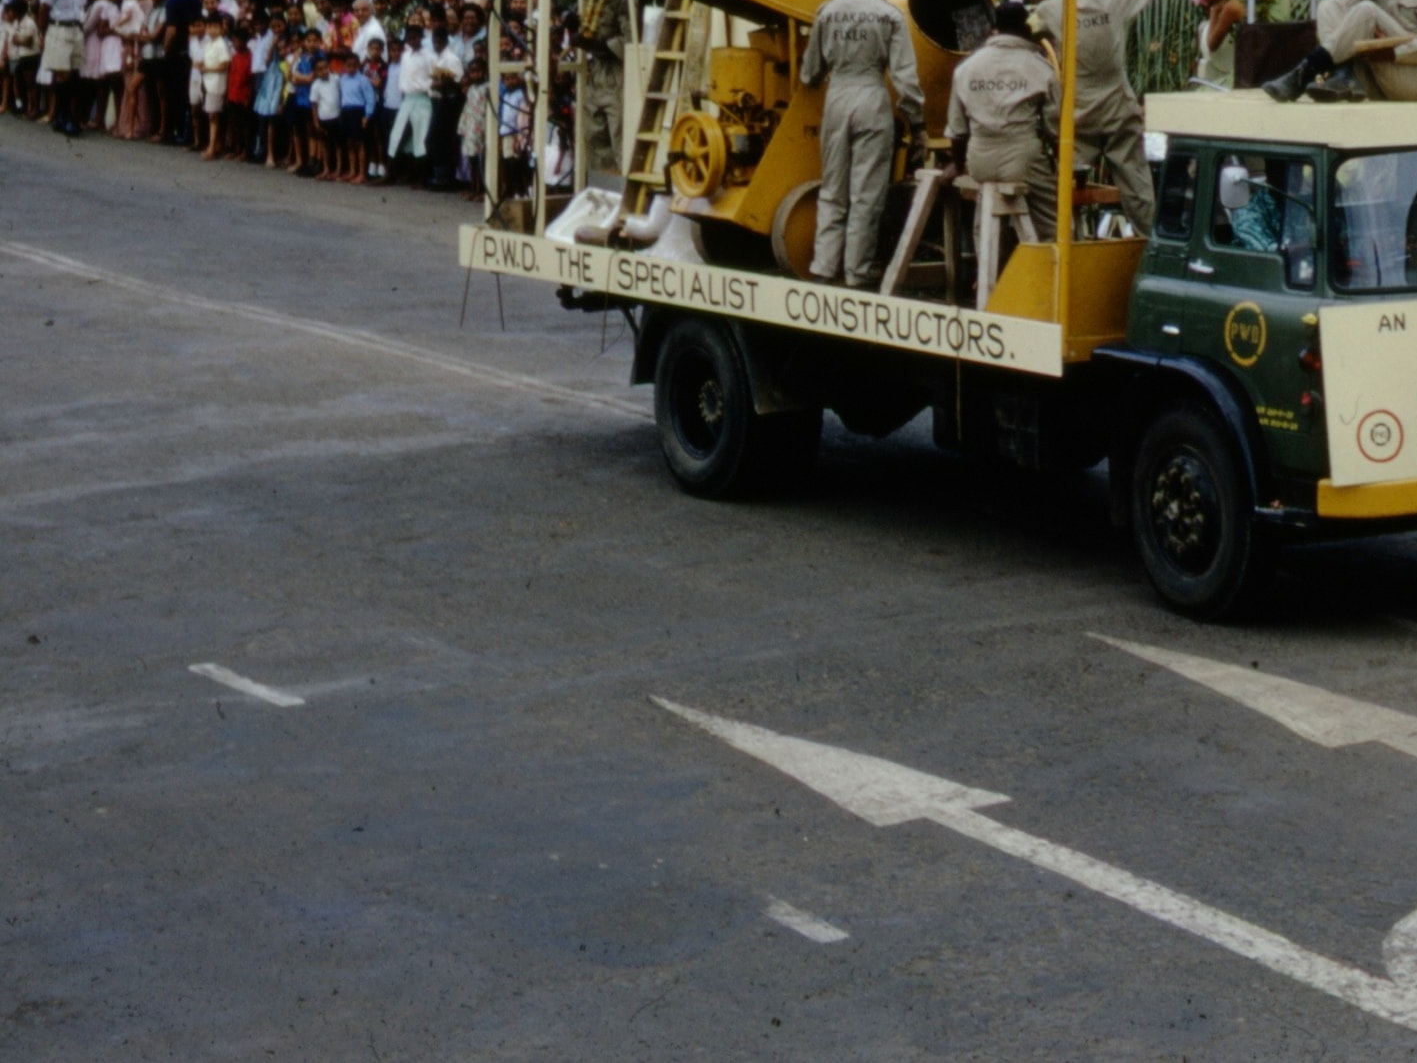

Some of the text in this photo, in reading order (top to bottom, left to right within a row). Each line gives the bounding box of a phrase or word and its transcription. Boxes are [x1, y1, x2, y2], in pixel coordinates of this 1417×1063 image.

[483, 237, 1015, 359] P.W.D. THE SPECIALIST CONSTRUCTORS.
[1231, 322, 1259, 344] PWD
[1378, 314, 1406, 332] AN
